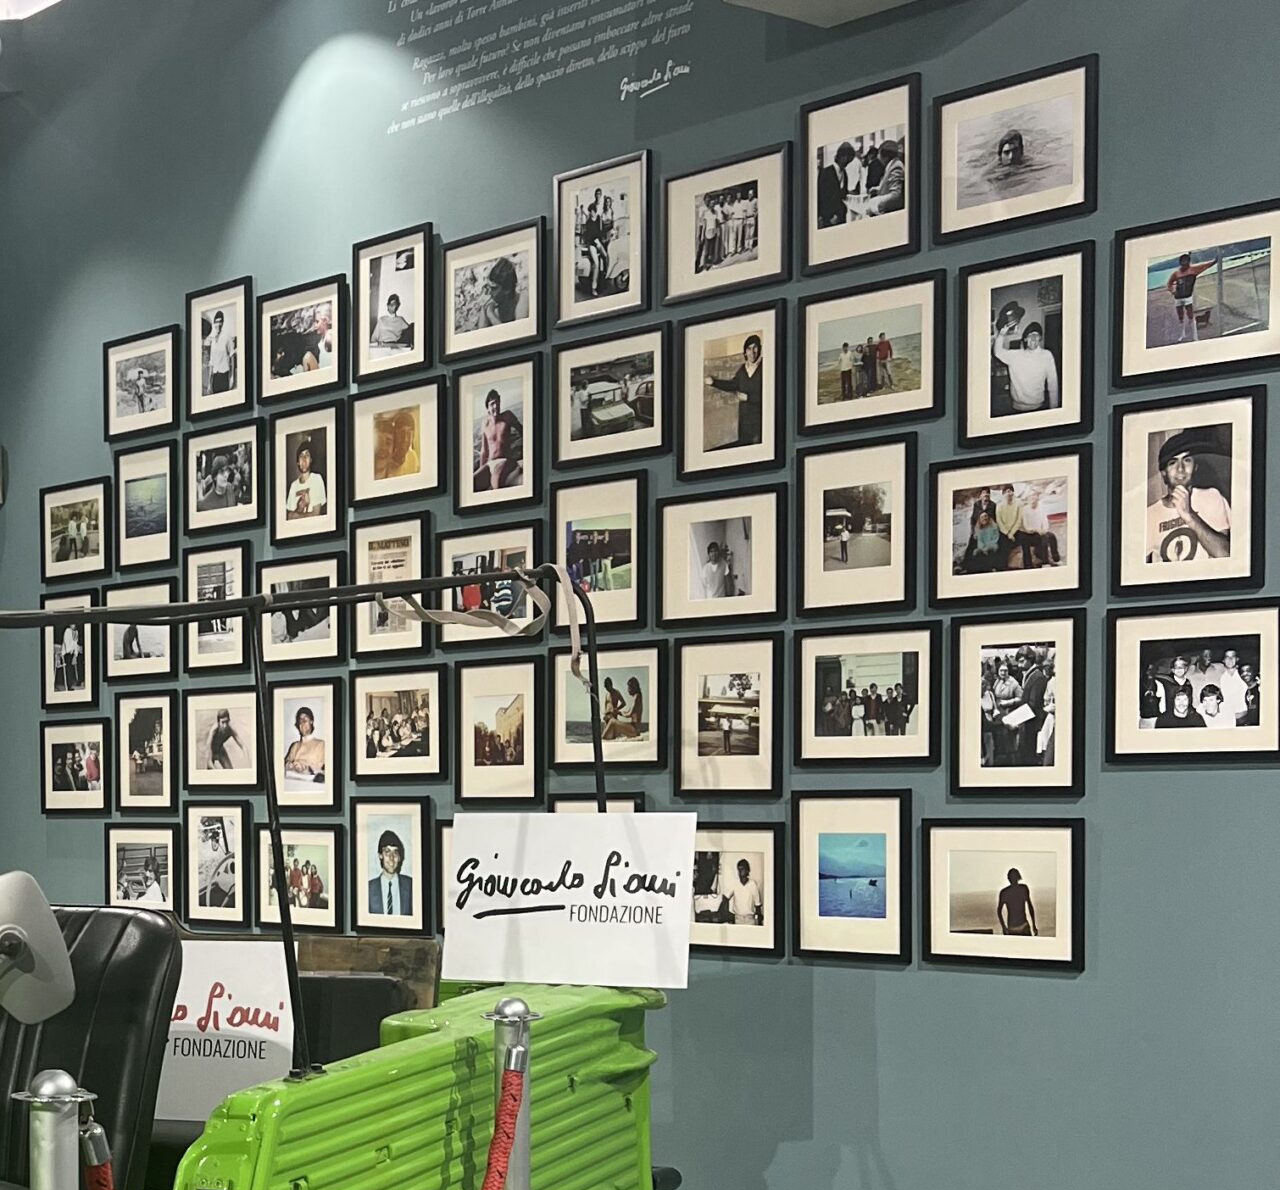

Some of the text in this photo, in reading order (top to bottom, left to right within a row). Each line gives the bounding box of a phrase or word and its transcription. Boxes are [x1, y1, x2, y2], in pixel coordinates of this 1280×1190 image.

[407, 25, 431, 41] dodici
[432, 18, 452, 32] anni
[466, 5, 487, 19] Torre
[410, 8, 423, 22] Un
[448, 39, 472, 56] molto
[474, 32, 496, 50] spesso
[498, 17, 537, 37] bambini,
[508, 51, 540, 75] difficile
[542, 46, 557, 61] che
[557, 37, 591, 61] possano
[593, 20, 639, 43] imboccare
[640, 10, 663, 27] altre
[664, 0, 695, 19] strade
[422, 71, 436, 84] Per
[437, 66, 453, 79] loro
[455, 54, 478, 76] quale
[511, 39, 521, 52] Se
[523, 36, 539, 48] non
[541, 19, 585, 42] diventano
[587, 0, 643, 25] consumatori
[387, 121, 399, 134] che
[401, 118, 415, 128] non
[437, 98, 460, 120] quelle
[461, 83, 512, 109] dell'illegalità,
[514, 73, 534, 90] dello
[535, 67, 564, 87] spaccio
[565, 57, 595, 73] diretto,
[596, 44, 618, 62] dello
[619, 38, 647, 56] scippo
[664, 23, 690, 44] furto
[456, 850, 681, 910] Giancarlo Siani
[569, 904, 664, 925] FONDAZIONE
[196, 981, 285, 1033] Siani
[173, 1037, 267, 1060] FONDAZIONE
